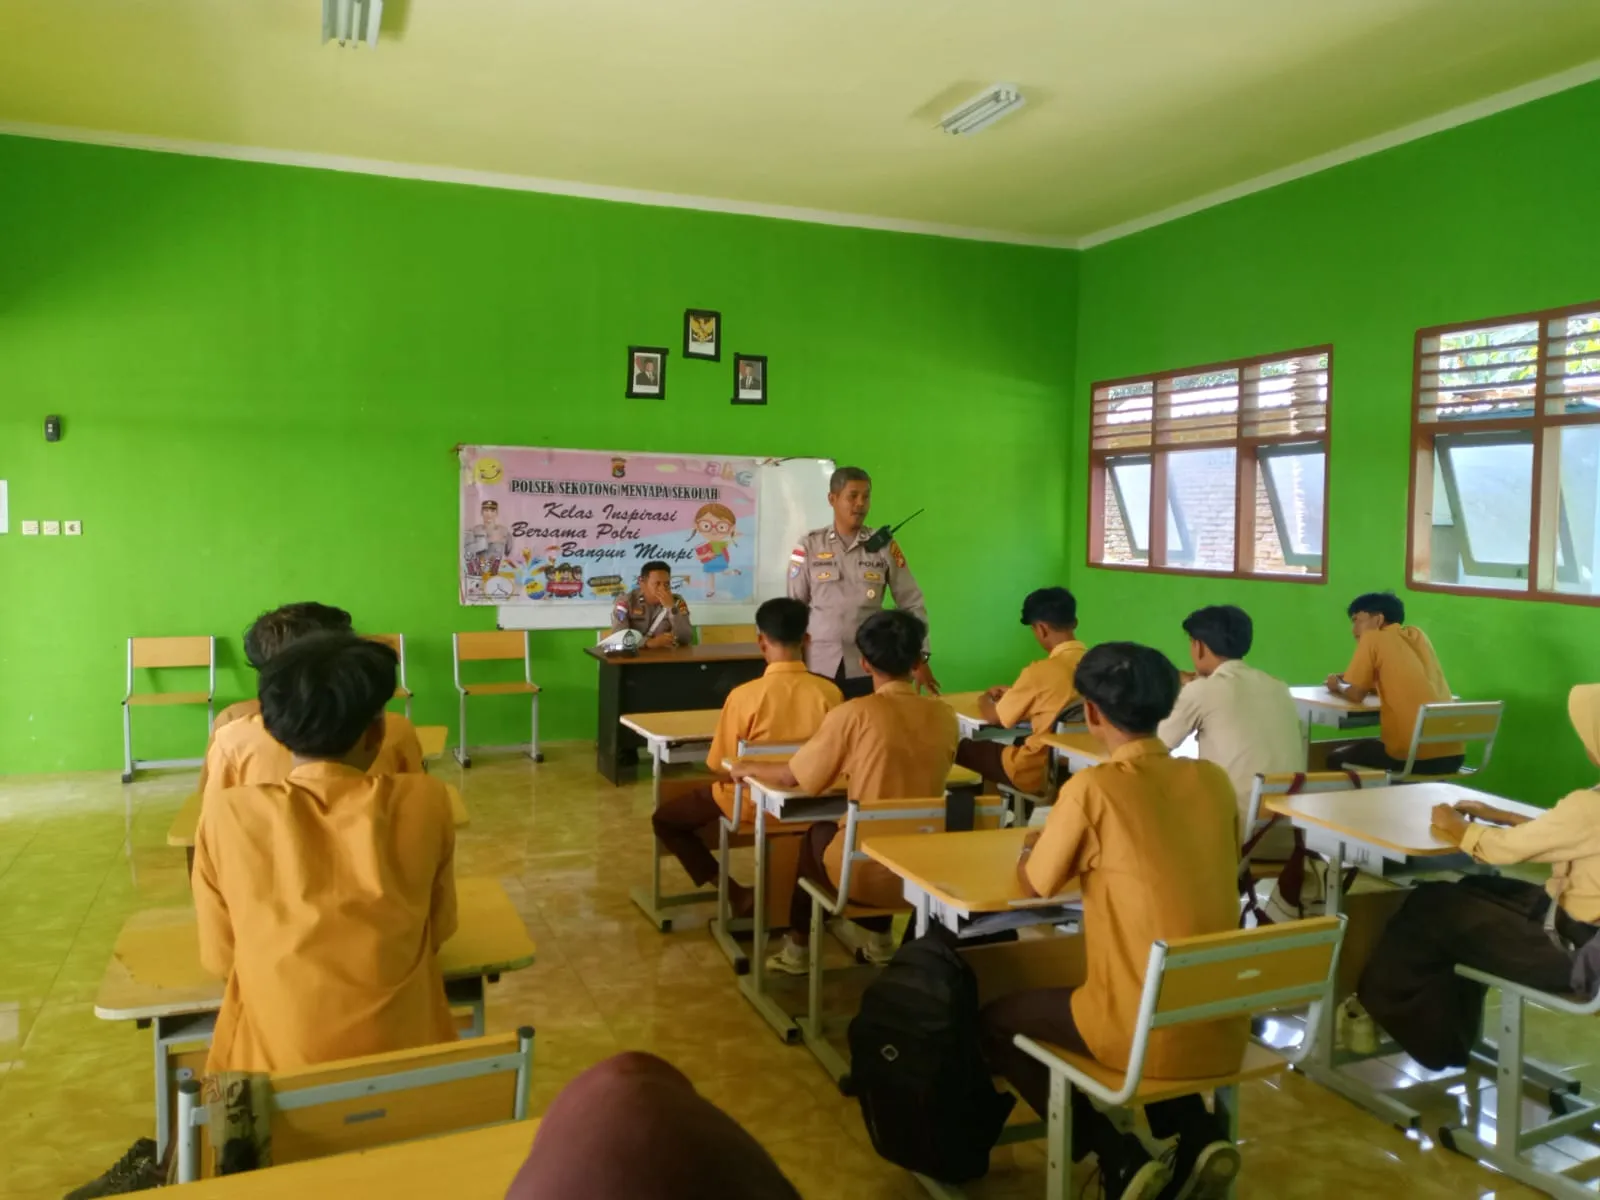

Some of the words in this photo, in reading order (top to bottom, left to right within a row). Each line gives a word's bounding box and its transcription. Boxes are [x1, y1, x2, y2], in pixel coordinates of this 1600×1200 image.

[511, 479, 555, 493] POLSEK
[559, 481, 617, 496] SEKOTONG
[620, 484, 668, 498] MENYAPA
[672, 486, 718, 500] SEKOLAH
[543, 502, 594, 520] Kelas
[602, 503, 678, 524] Inspirasi
[511, 521, 588, 538] Bersama
[596, 523, 641, 540] Polri
[560, 541, 627, 563] Bangun
[633, 542, 694, 563] Mimpi
